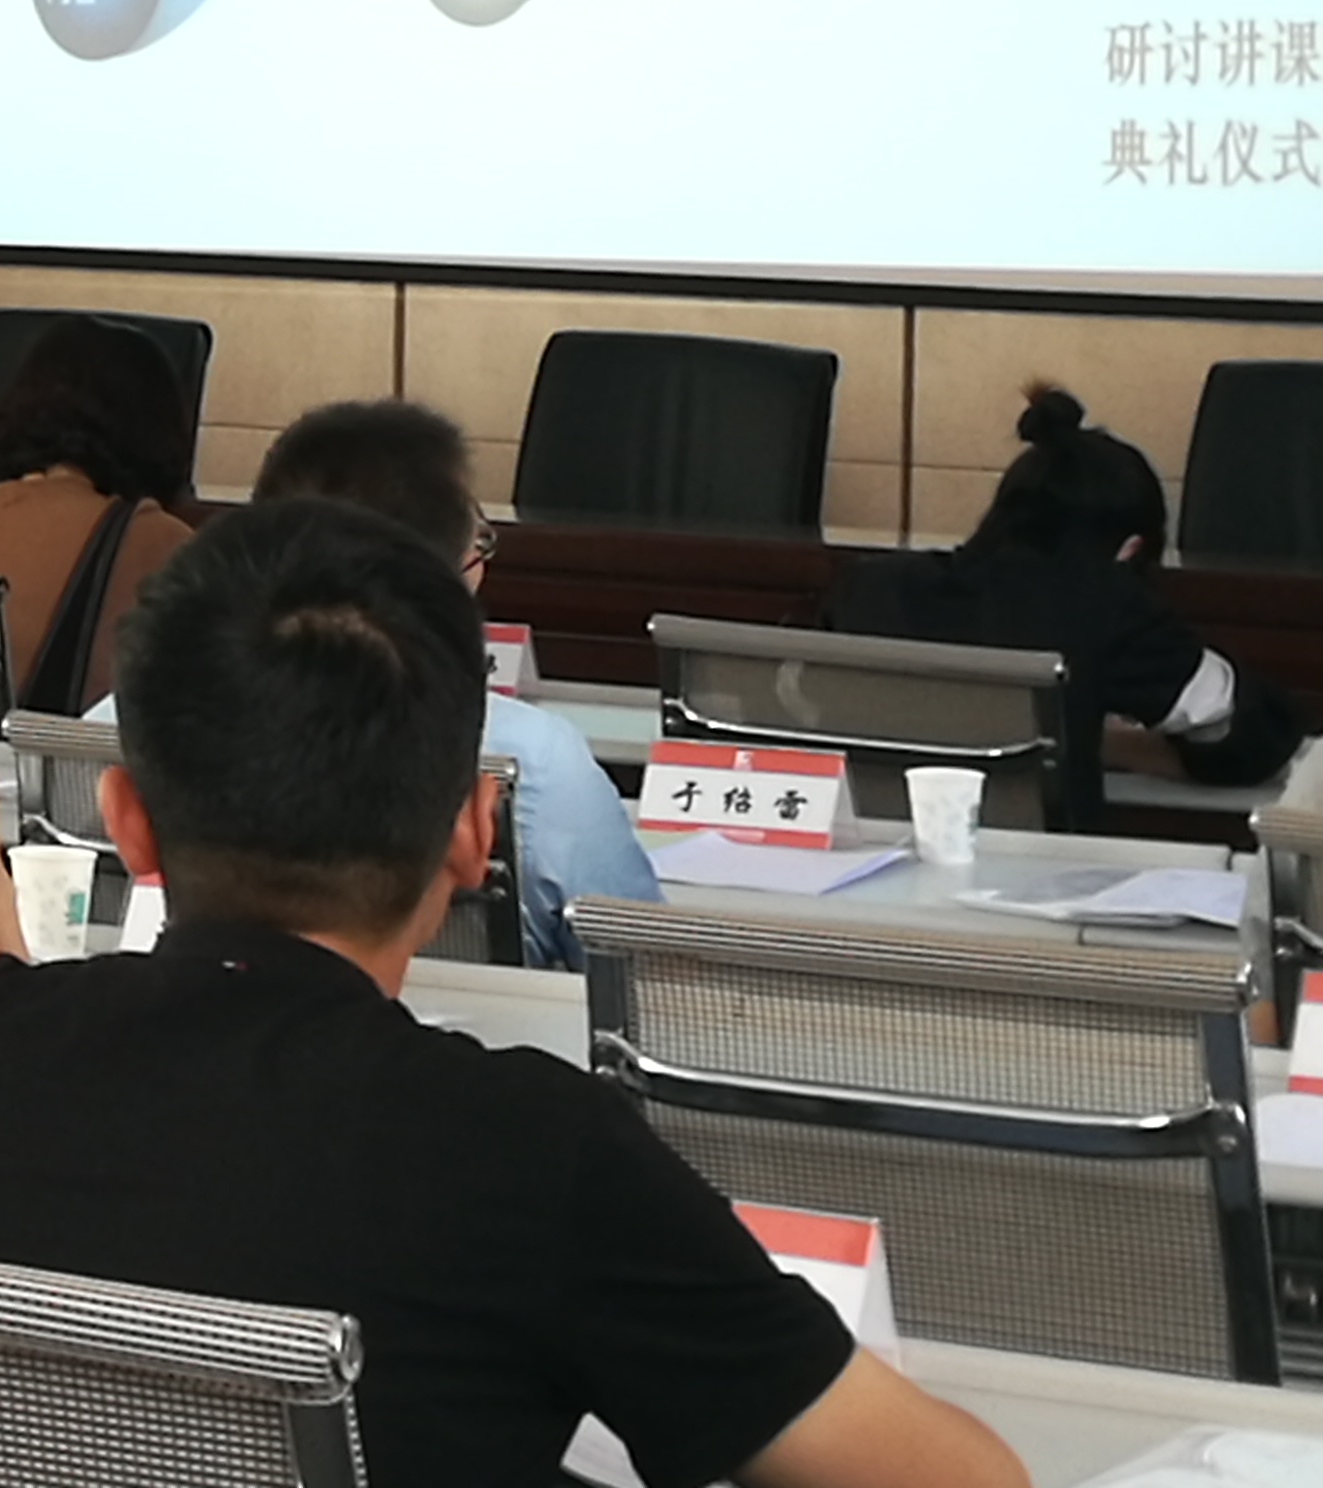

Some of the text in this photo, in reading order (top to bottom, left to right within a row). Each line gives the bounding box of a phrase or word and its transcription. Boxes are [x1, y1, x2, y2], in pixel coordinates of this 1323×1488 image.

[1104, 18, 1321, 88] 研讨讲课
[1102, 118, 1322, 188] 典礼仪式
